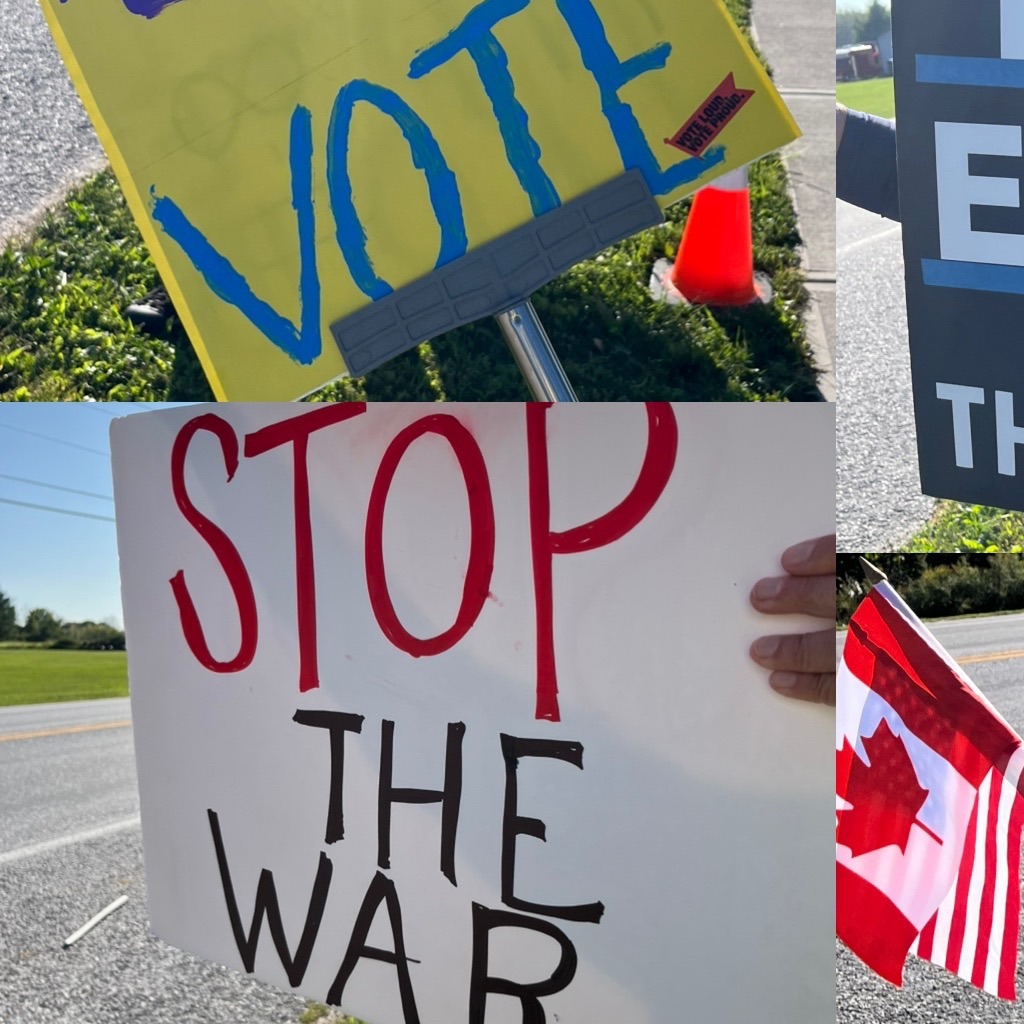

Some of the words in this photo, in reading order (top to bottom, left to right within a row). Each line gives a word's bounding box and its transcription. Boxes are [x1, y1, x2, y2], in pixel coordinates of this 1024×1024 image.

[676, 120, 702, 148] VOTE
[686, 124, 714, 153] VOTE
[709, 92, 745, 129] PROUD.
[169, 403, 679, 722] STOP
[207, 808, 578, 1024] WAR
[292, 708, 605, 924] THE
